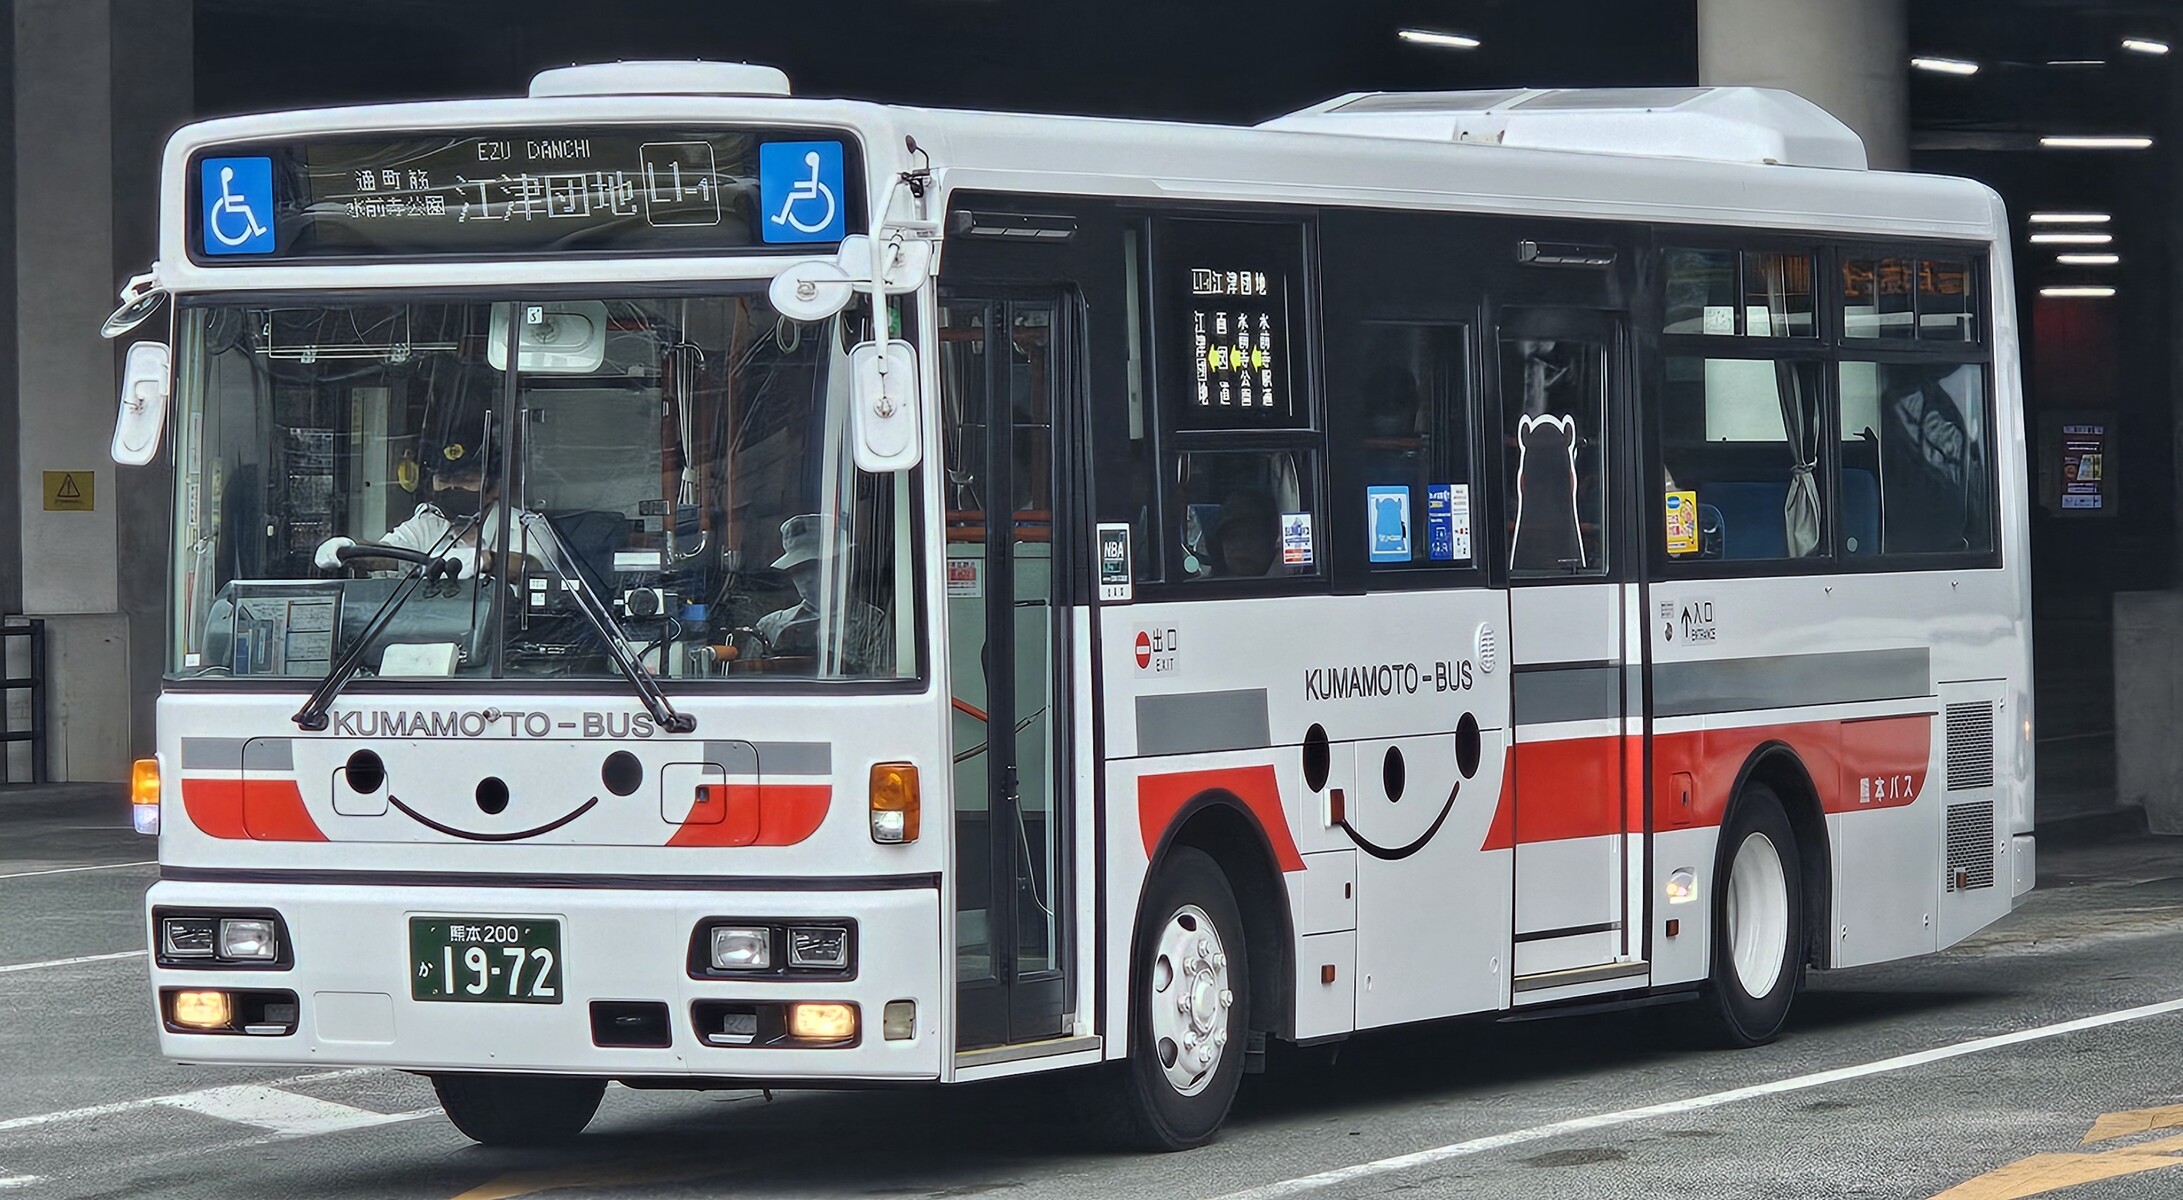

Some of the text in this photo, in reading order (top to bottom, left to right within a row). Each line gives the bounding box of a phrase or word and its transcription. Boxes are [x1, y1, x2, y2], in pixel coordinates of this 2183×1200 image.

[477, 139, 590, 161] EZU DANCHI
[346, 195, 446, 218] 水前寺公園
[455, 171, 638, 222] 江津団地
[1212, 271, 1267, 295] 江津団地
[1104, 541, 1124, 558] NBA
[1694, 602, 1713, 624] 入口
[1153, 628, 1176, 652] 出口
[1156, 658, 1174, 672] EXIT
[418, 946, 555, 997] か 19-72
